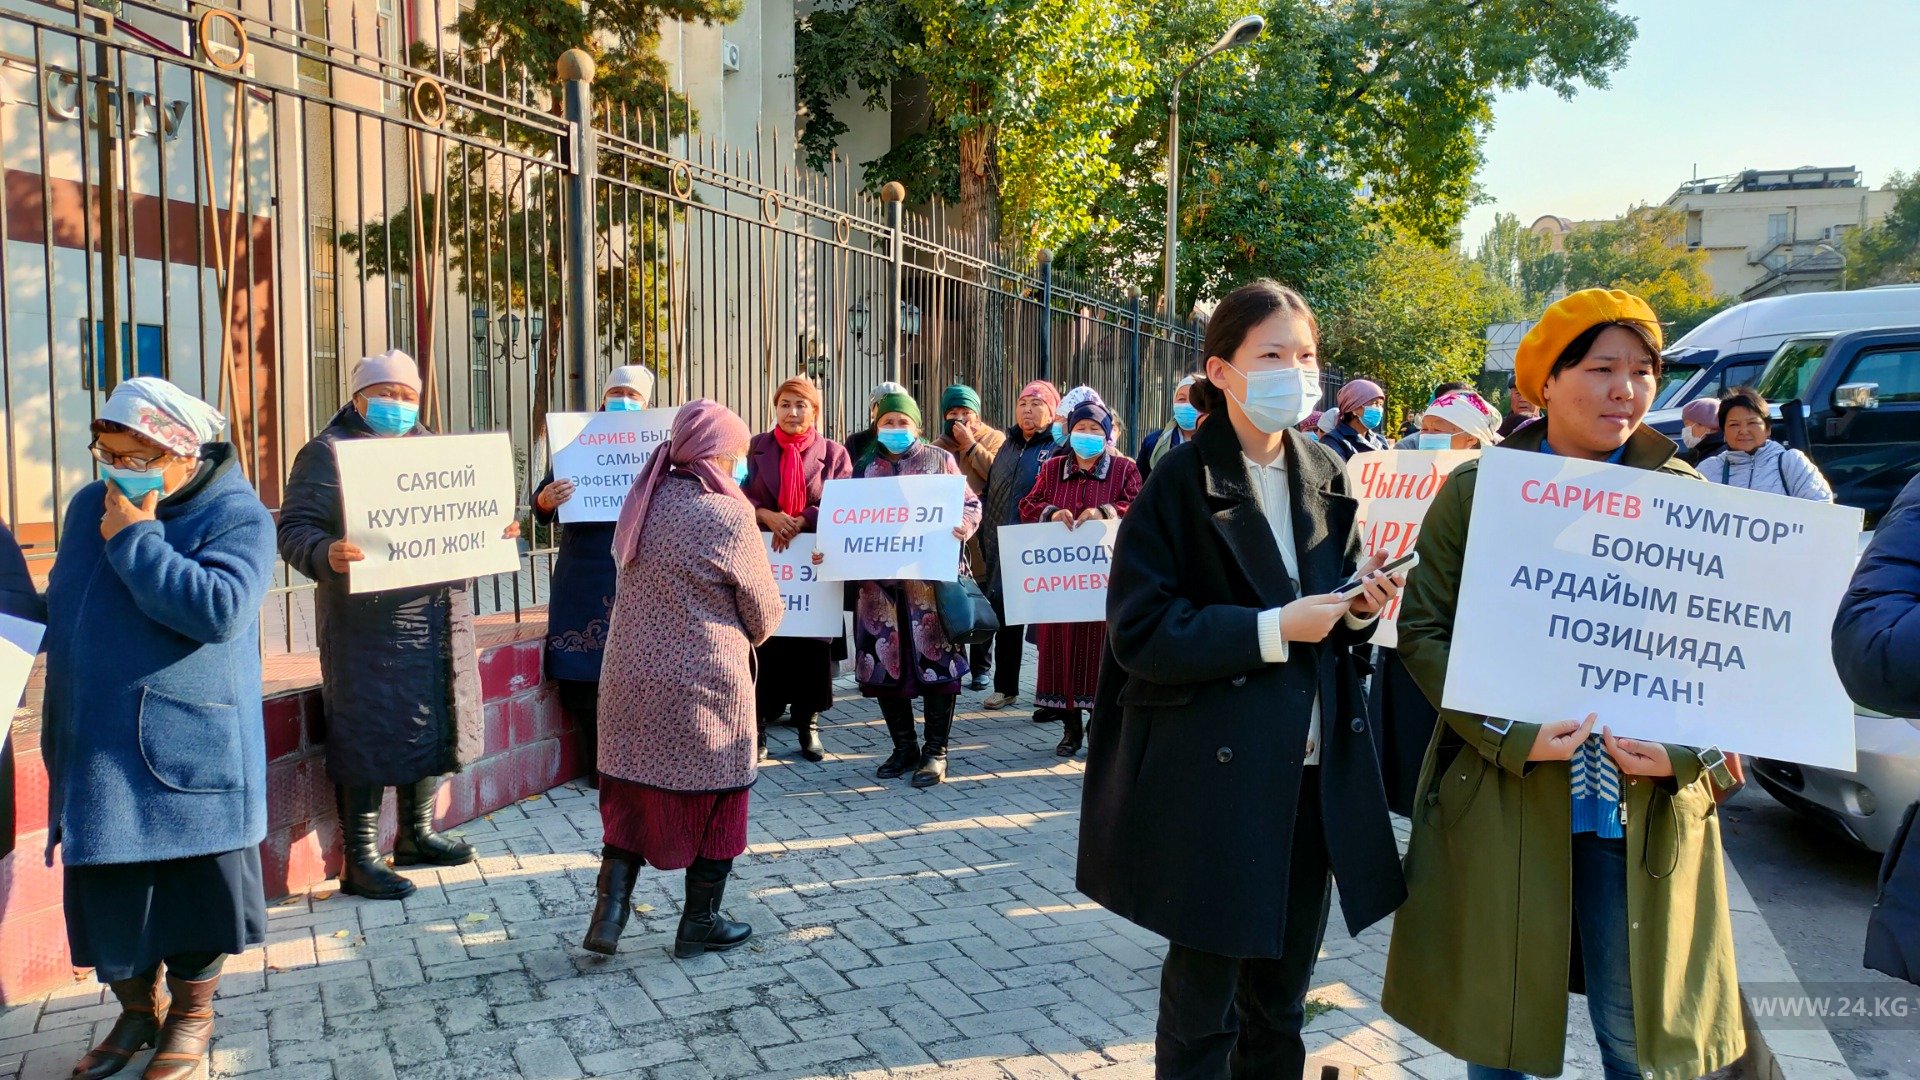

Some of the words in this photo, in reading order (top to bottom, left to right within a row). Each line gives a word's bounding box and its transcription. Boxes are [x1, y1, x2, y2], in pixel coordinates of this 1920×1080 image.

[578, 431, 636, 446] САРИЕВ
[397, 464, 476, 492] САЯСИЙ
[367, 499, 499, 529] КУУГУНТУККА
[584, 495, 627, 508] ПРЕМ
[832, 507, 910, 525] САРИЕВ
[915, 506, 944, 523] ЭЛ
[1521, 478, 1642, 519] САРИЕВ
[1653, 498, 1804, 545] "КУМТОР"
[388, 538, 436, 561] ЖОЛ
[442, 530, 486, 555] ЖОК!
[844, 535, 924, 553] МЕНЕН!
[1591, 533, 1724, 580] БОЮНЧА
[1510, 565, 1676, 615] АРДАЙЫМ
[1687, 594, 1792, 634] БЕКЕМ
[1548, 614, 1746, 671] ПОЗИЦИЯДА
[1577, 663, 1704, 707] ТУРГАН!
